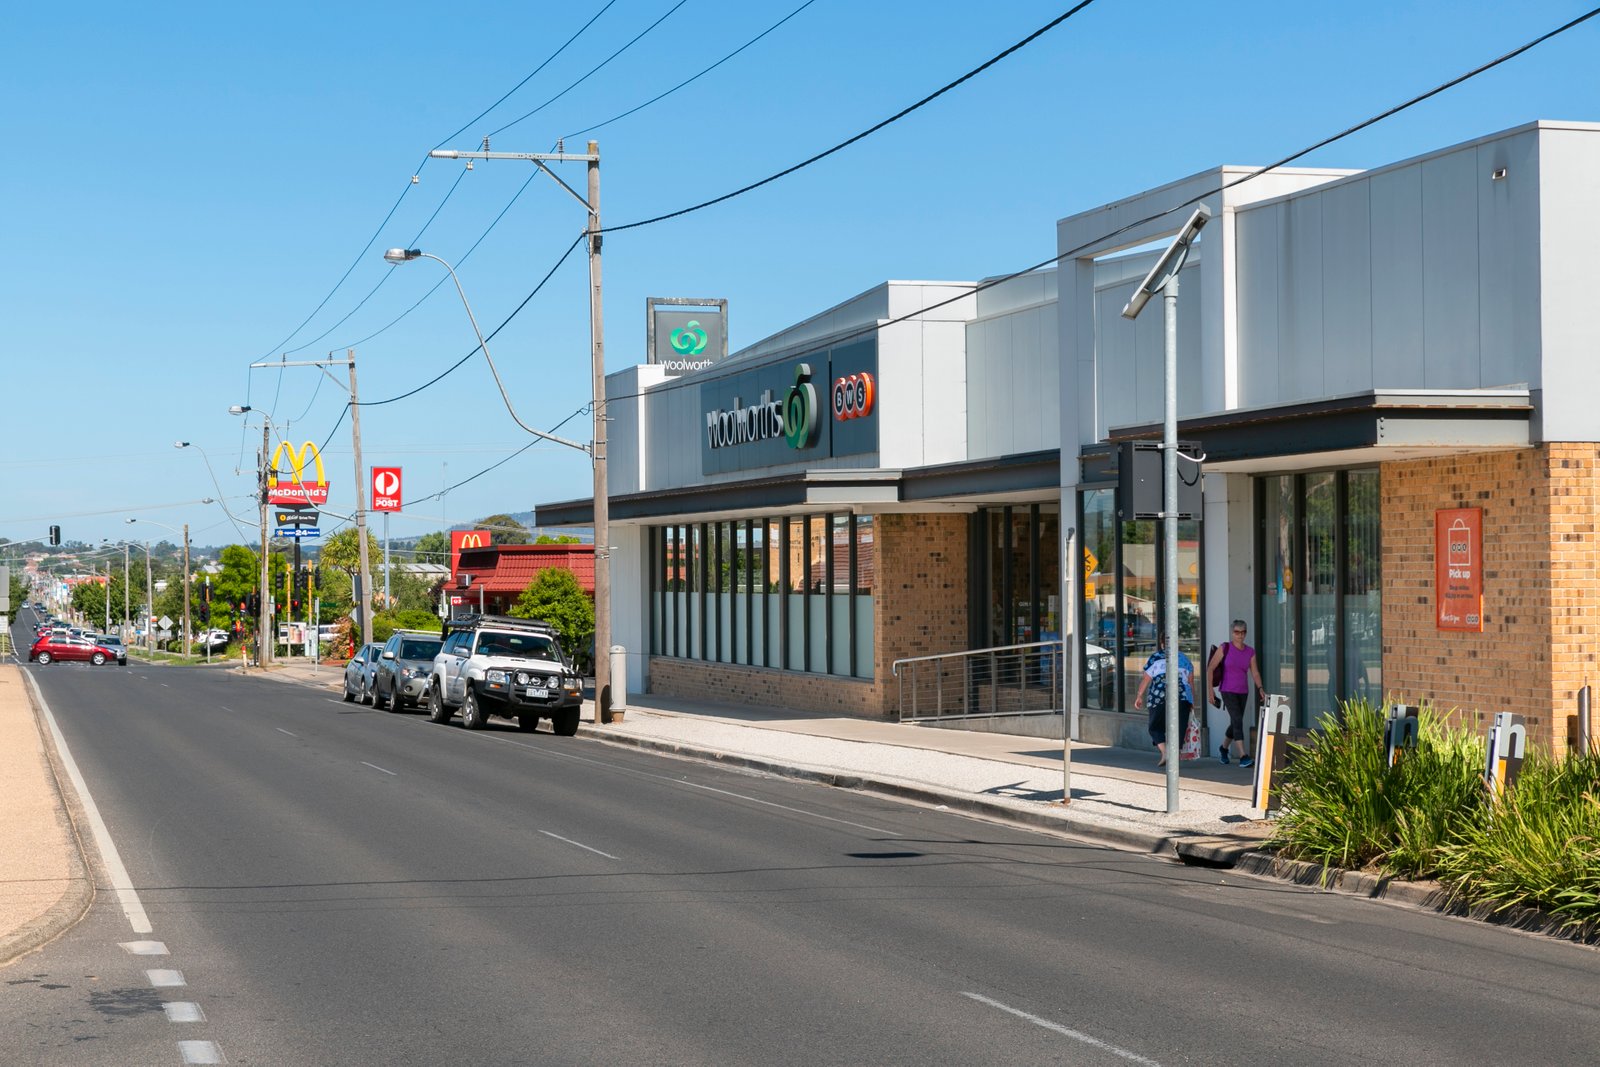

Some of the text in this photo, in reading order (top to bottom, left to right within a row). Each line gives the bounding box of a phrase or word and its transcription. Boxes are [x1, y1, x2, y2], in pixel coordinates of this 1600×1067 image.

[660, 358, 713, 371] Woolworth
[706, 389, 784, 449] Woolworths
[268, 488, 328, 497] McDonald's
[375, 499, 399, 507] POST
[1448, 568, 1471, 580] Pick up
